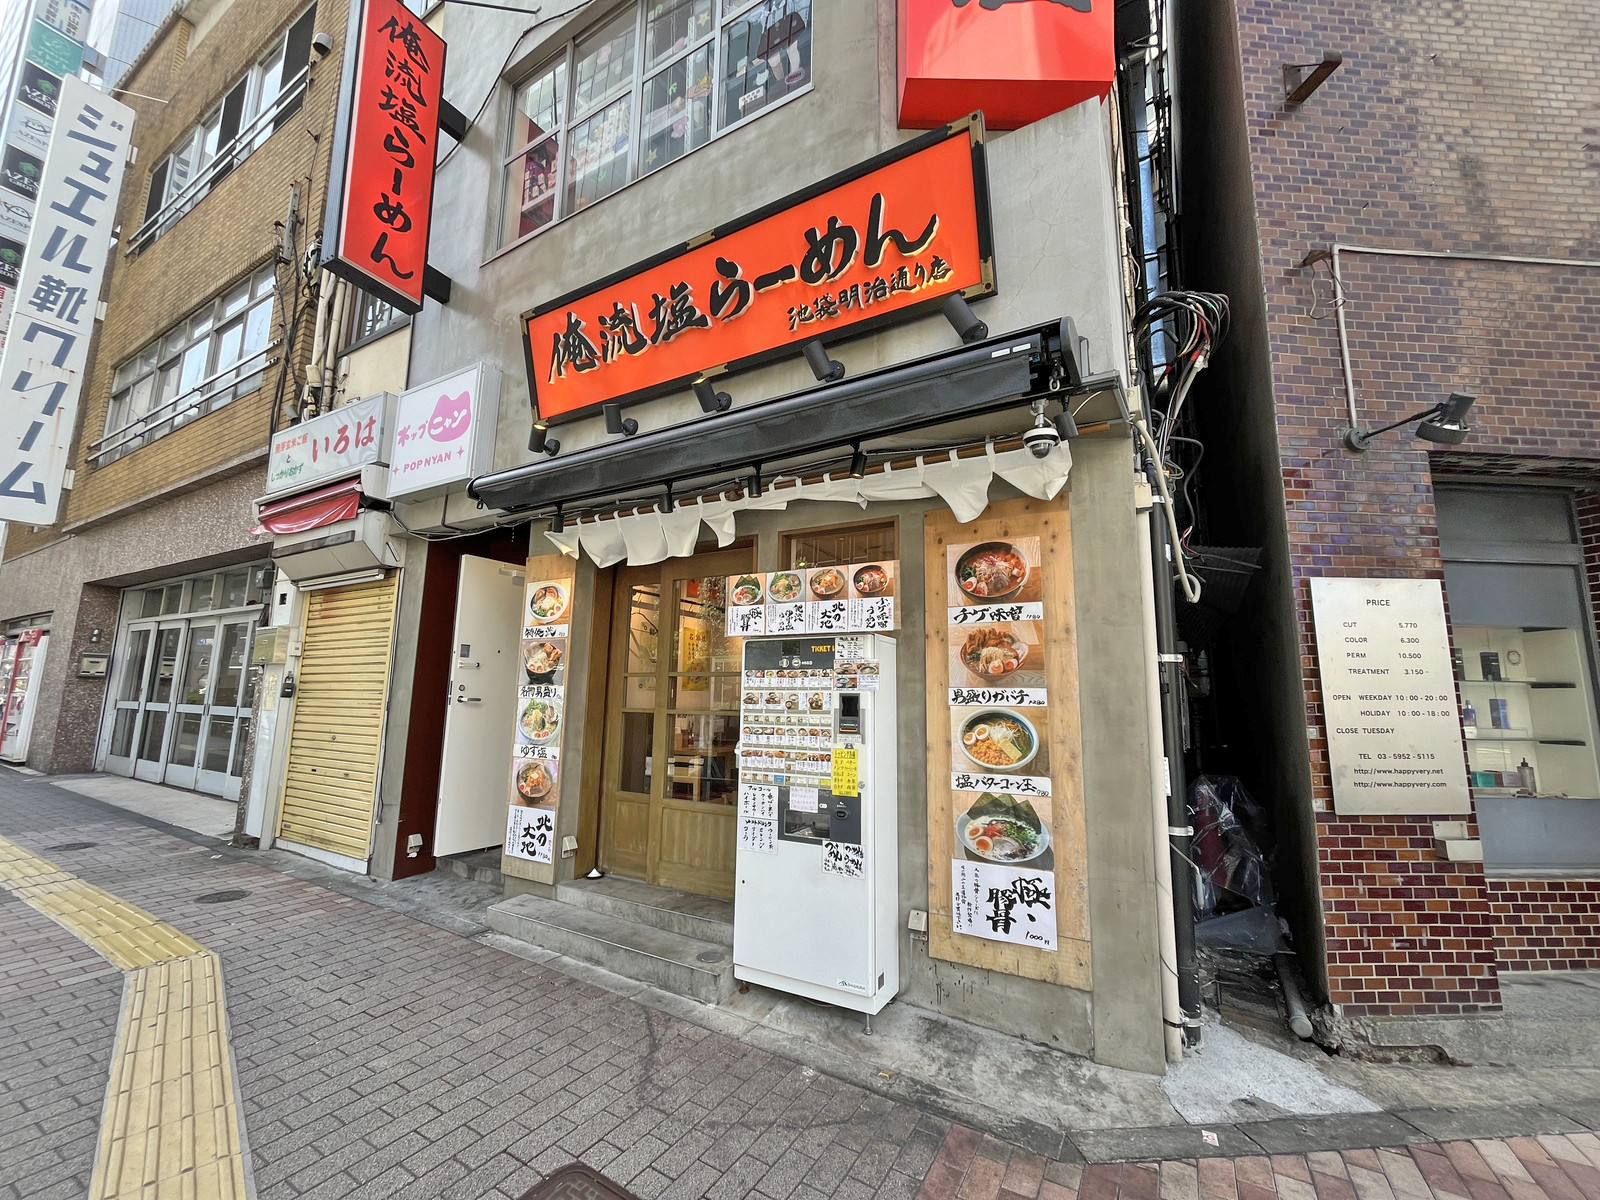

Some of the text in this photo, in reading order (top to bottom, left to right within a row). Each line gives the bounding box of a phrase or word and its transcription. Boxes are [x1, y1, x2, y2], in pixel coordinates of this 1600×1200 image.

[371, 16, 430, 279] 俺流塩らーめん
[0, 103, 124, 506] ジュエル靴クリーム
[547, 192, 940, 384] 俺流塩らーめん
[787, 255, 955, 333] 池袋明治通り店
[312, 415, 377, 463] いろは
[286, 454, 292, 464] と
[403, 451, 452, 473] POPNYAN
[953, 605, 1024, 625] チゲ味噌
[1366, 599, 1391, 607] PRICE
[811, 645, 831, 653] TICKET
[520, 822, 537, 857] 大地
[535, 814, 553, 848] 北の
